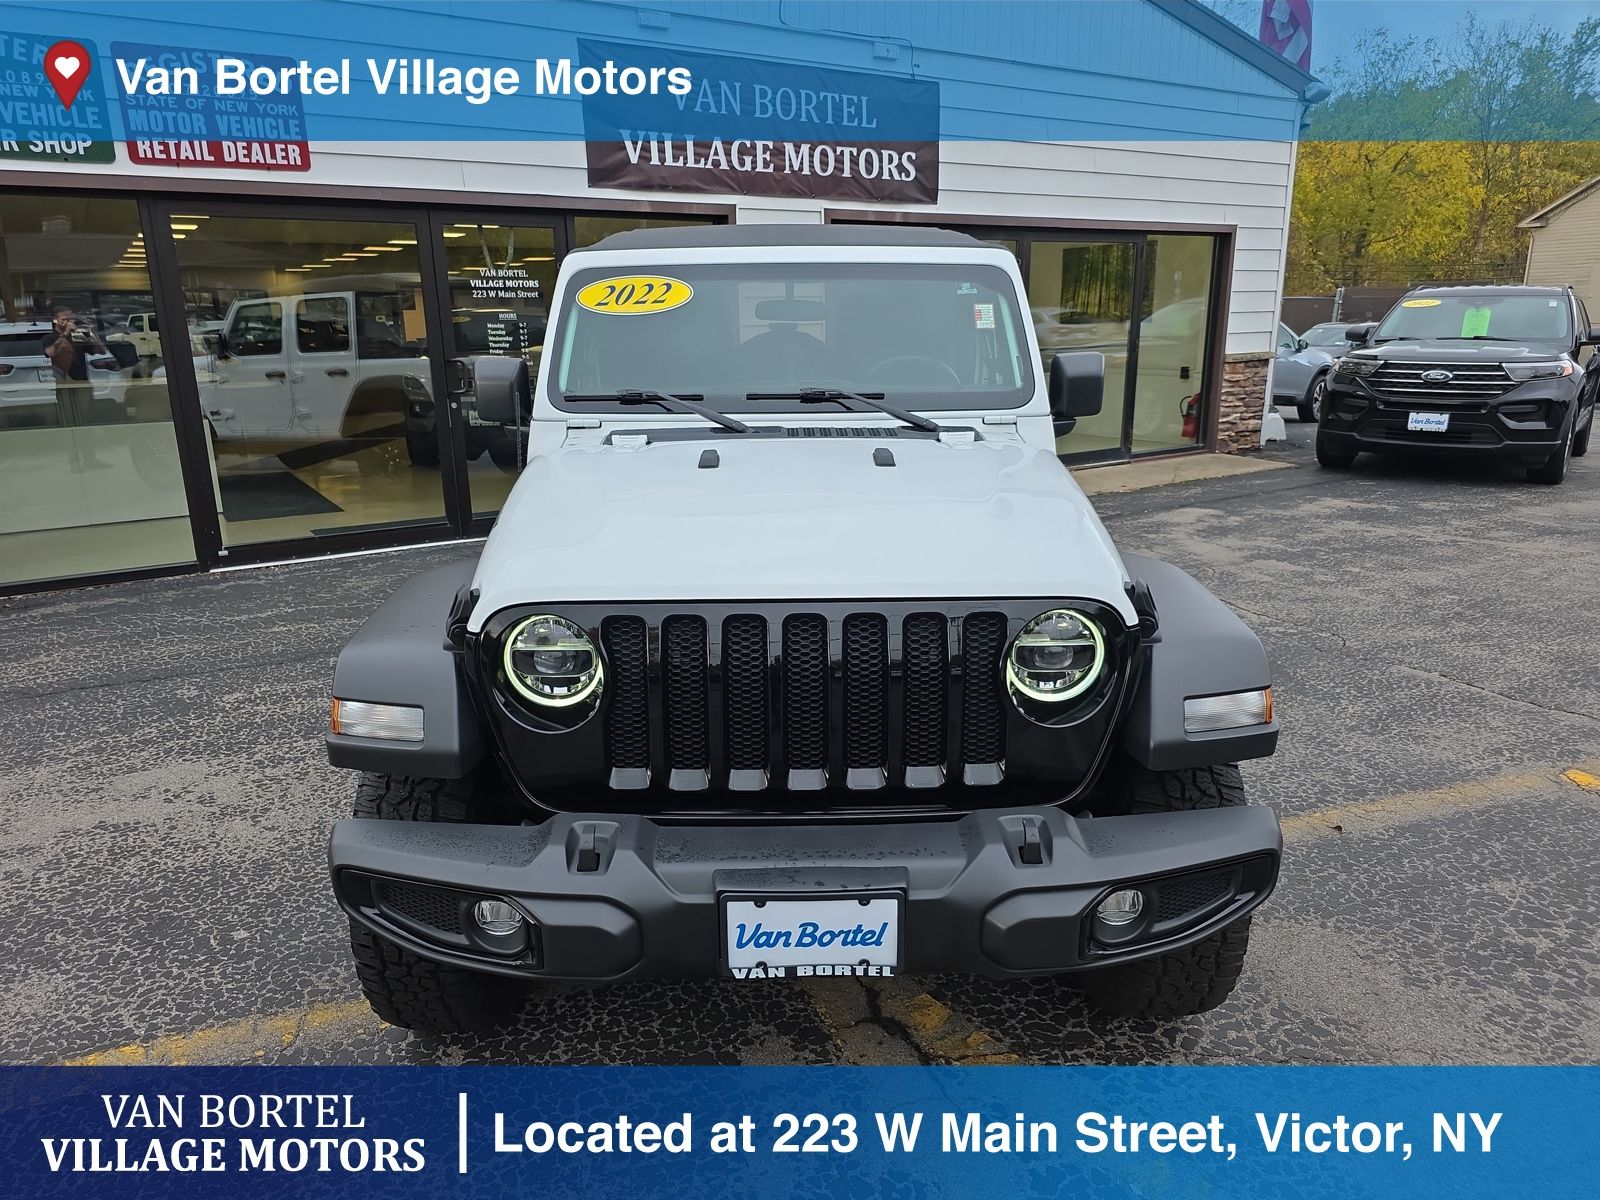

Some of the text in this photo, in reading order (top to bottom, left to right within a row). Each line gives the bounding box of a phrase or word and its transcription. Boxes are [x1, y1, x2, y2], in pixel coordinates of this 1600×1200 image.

[0, 101, 102, 129] VEHICLE
[126, 93, 299, 117] STATE OF NEW YORK
[673, 77, 878, 129] VAN BORTEL
[127, 108, 302, 140] MOTOR VEHICLE
[28, 130, 93, 155] SHOP
[135, 136, 302, 166] RETAIL DEALER
[619, 128, 917, 182] VILLAGE MOTORS
[470, 279, 539, 288] VILLAGE MOTORS
[480, 269, 529, 278] VAN BORTEL
[472, 290, 487, 298] 223
[488, 290, 497, 298] W
[517, 290, 539, 299] Street
[594, 282, 673, 307] 2022
[499, 312, 517, 320] HOURS
[736, 921, 889, 949] Van Bortel
[732, 964, 895, 980] VAN BORTEL
